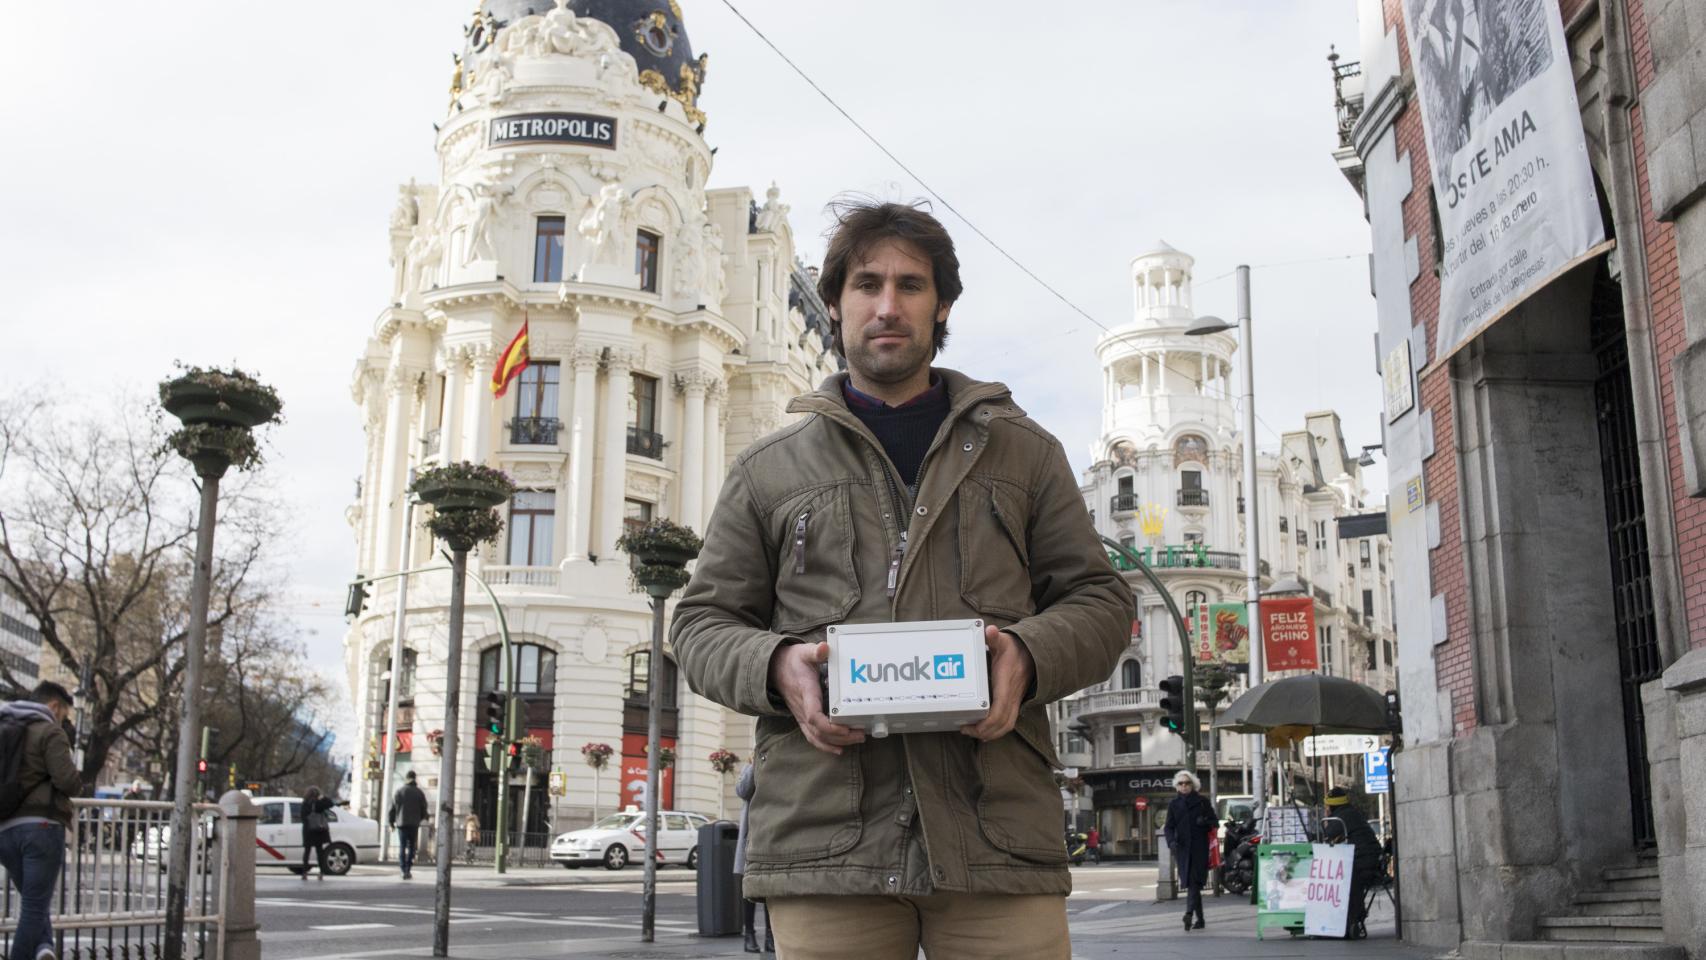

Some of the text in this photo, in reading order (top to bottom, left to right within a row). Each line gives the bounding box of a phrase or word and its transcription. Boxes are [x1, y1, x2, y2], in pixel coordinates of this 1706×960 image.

[494, 118, 612, 143] METROPOLIS
[1494, 109, 1537, 166] AMA
[1507, 161, 1534, 196] 20:30
[1469, 231, 1487, 256] del
[1511, 191, 1537, 222] enero
[1508, 248, 1528, 269] calle
[1269, 611, 1307, 625] FELIZ
[1271, 630, 1310, 643] CHINO
[850, 655, 962, 684] kunak air
[1368, 751, 1385, 774] P
[1309, 858, 1345, 881] ELLA
[1307, 882, 1342, 908] OCIAL
